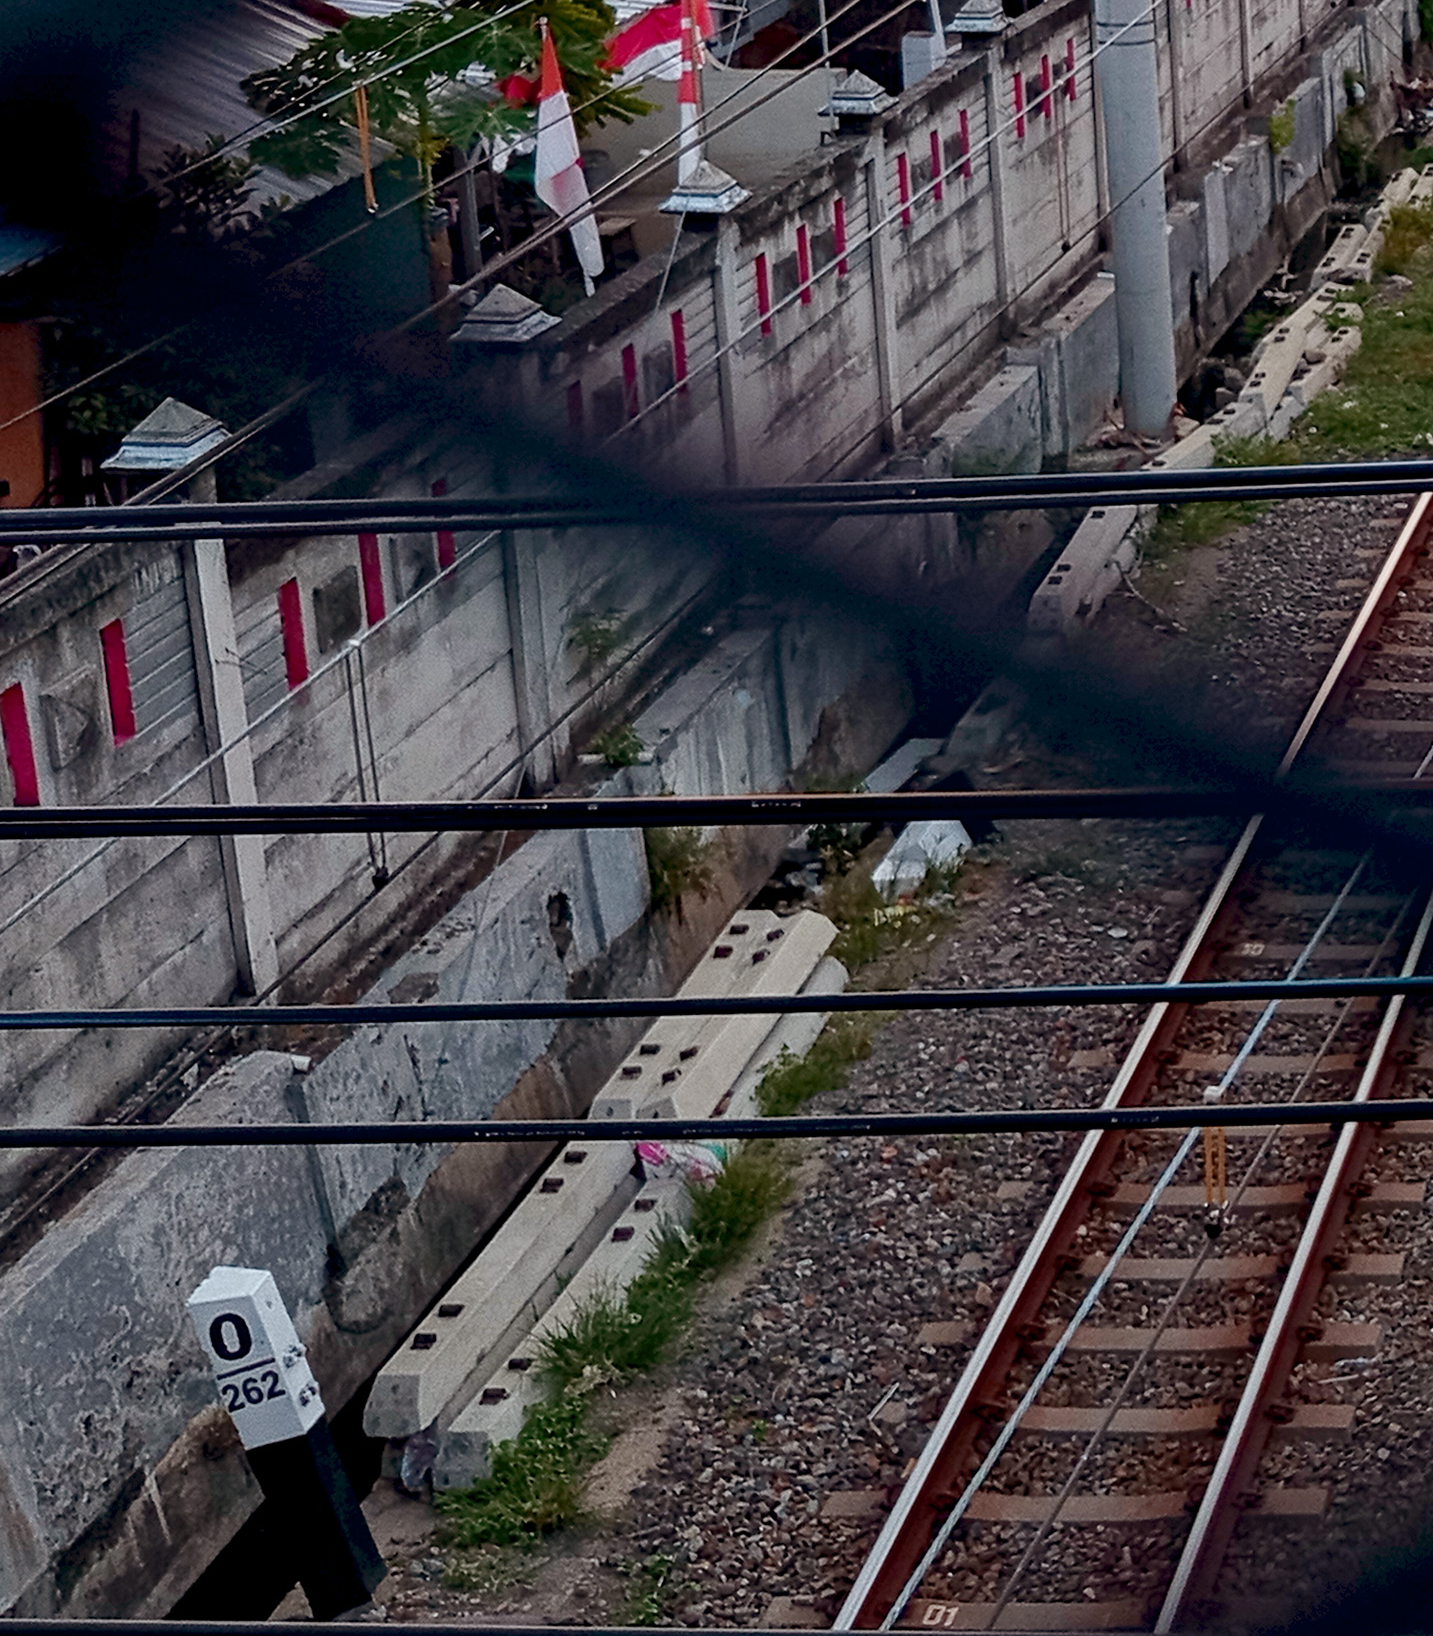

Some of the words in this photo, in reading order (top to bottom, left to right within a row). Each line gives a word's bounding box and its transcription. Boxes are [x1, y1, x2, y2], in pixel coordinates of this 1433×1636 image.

[209, 1313, 252, 1361] 0
[221, 1370, 286, 1413] 262
[922, 1604, 959, 1626] 01
